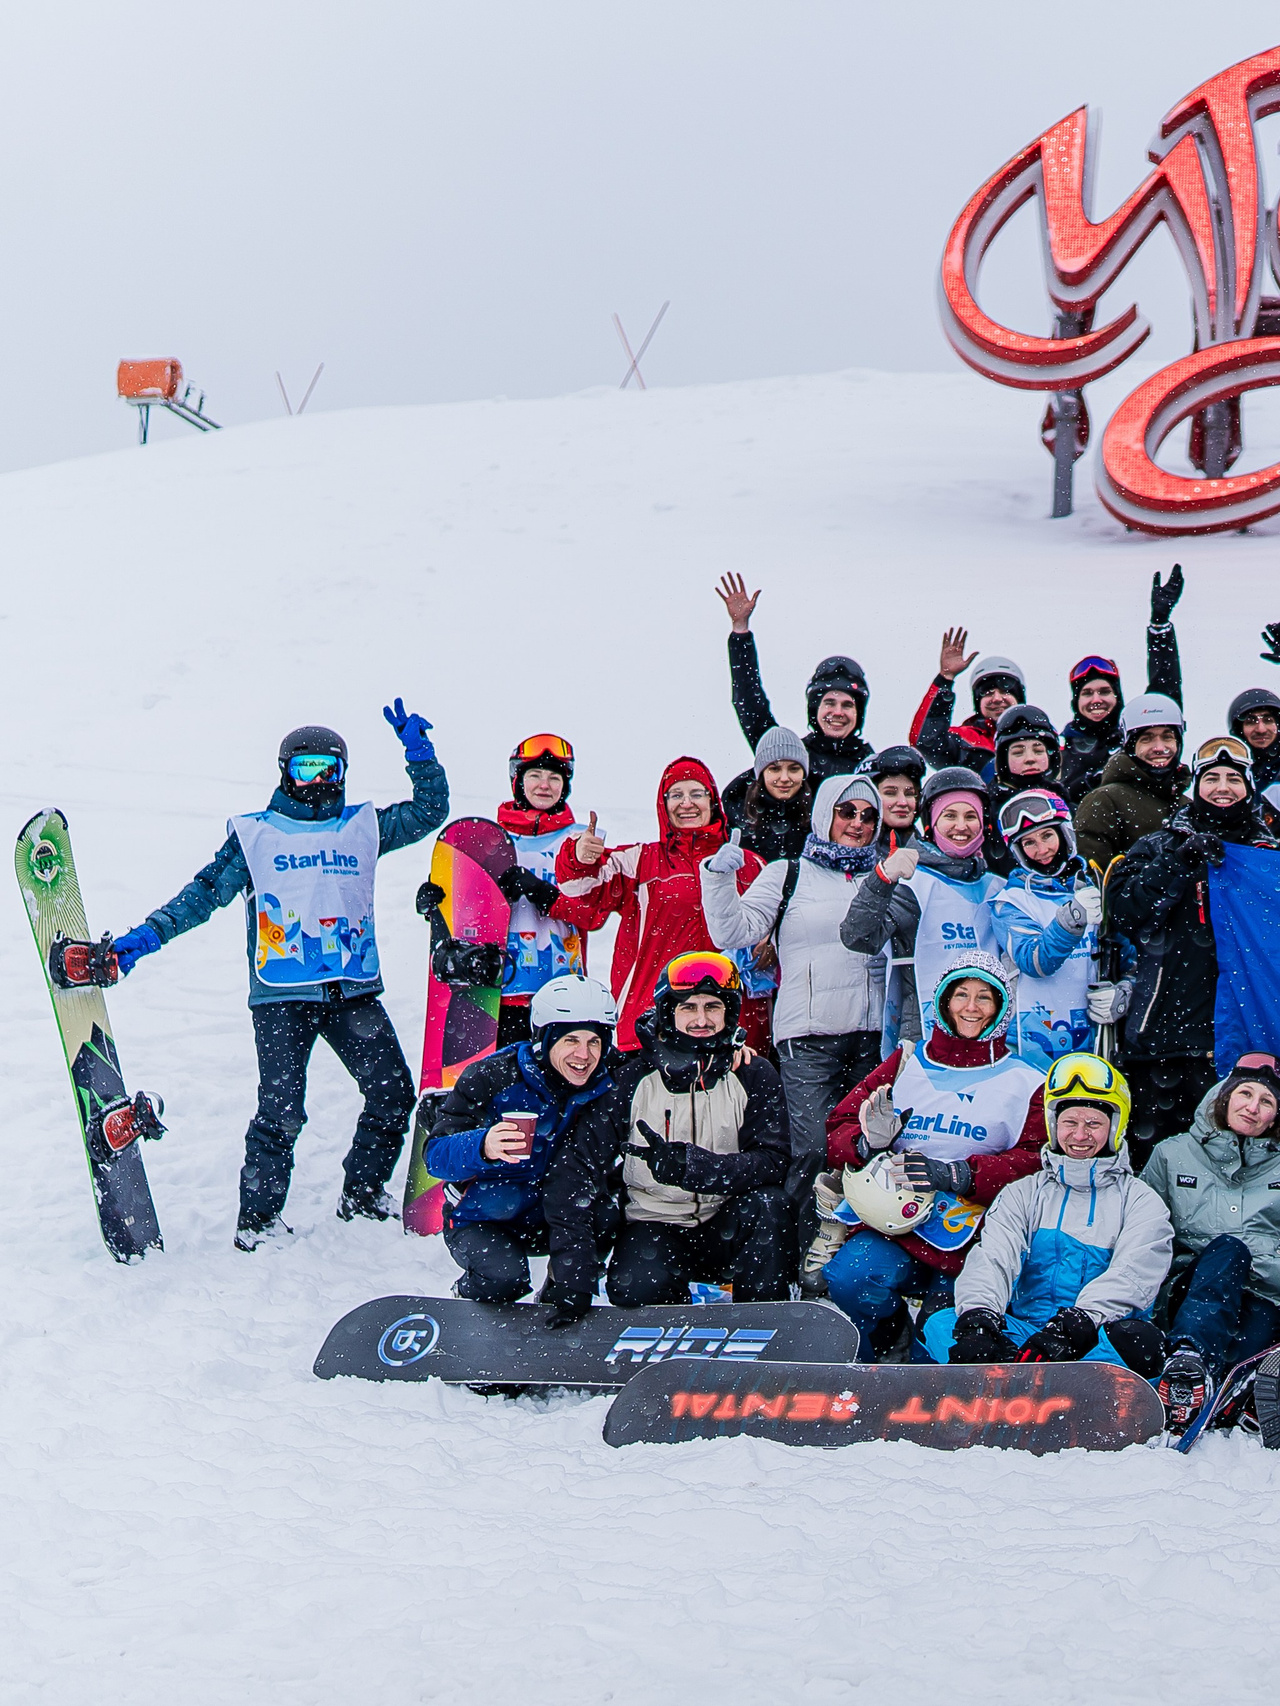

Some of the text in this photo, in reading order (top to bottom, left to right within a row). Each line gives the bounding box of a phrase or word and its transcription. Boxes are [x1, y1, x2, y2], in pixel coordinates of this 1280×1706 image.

[273, 849, 359, 872] StarLine
[893, 1108, 988, 1141] arLine
[1179, 1176, 1195, 1184] WGY
[604, 1326, 778, 1362] RIDE
[889, 1396, 1071, 1424] JOINT
